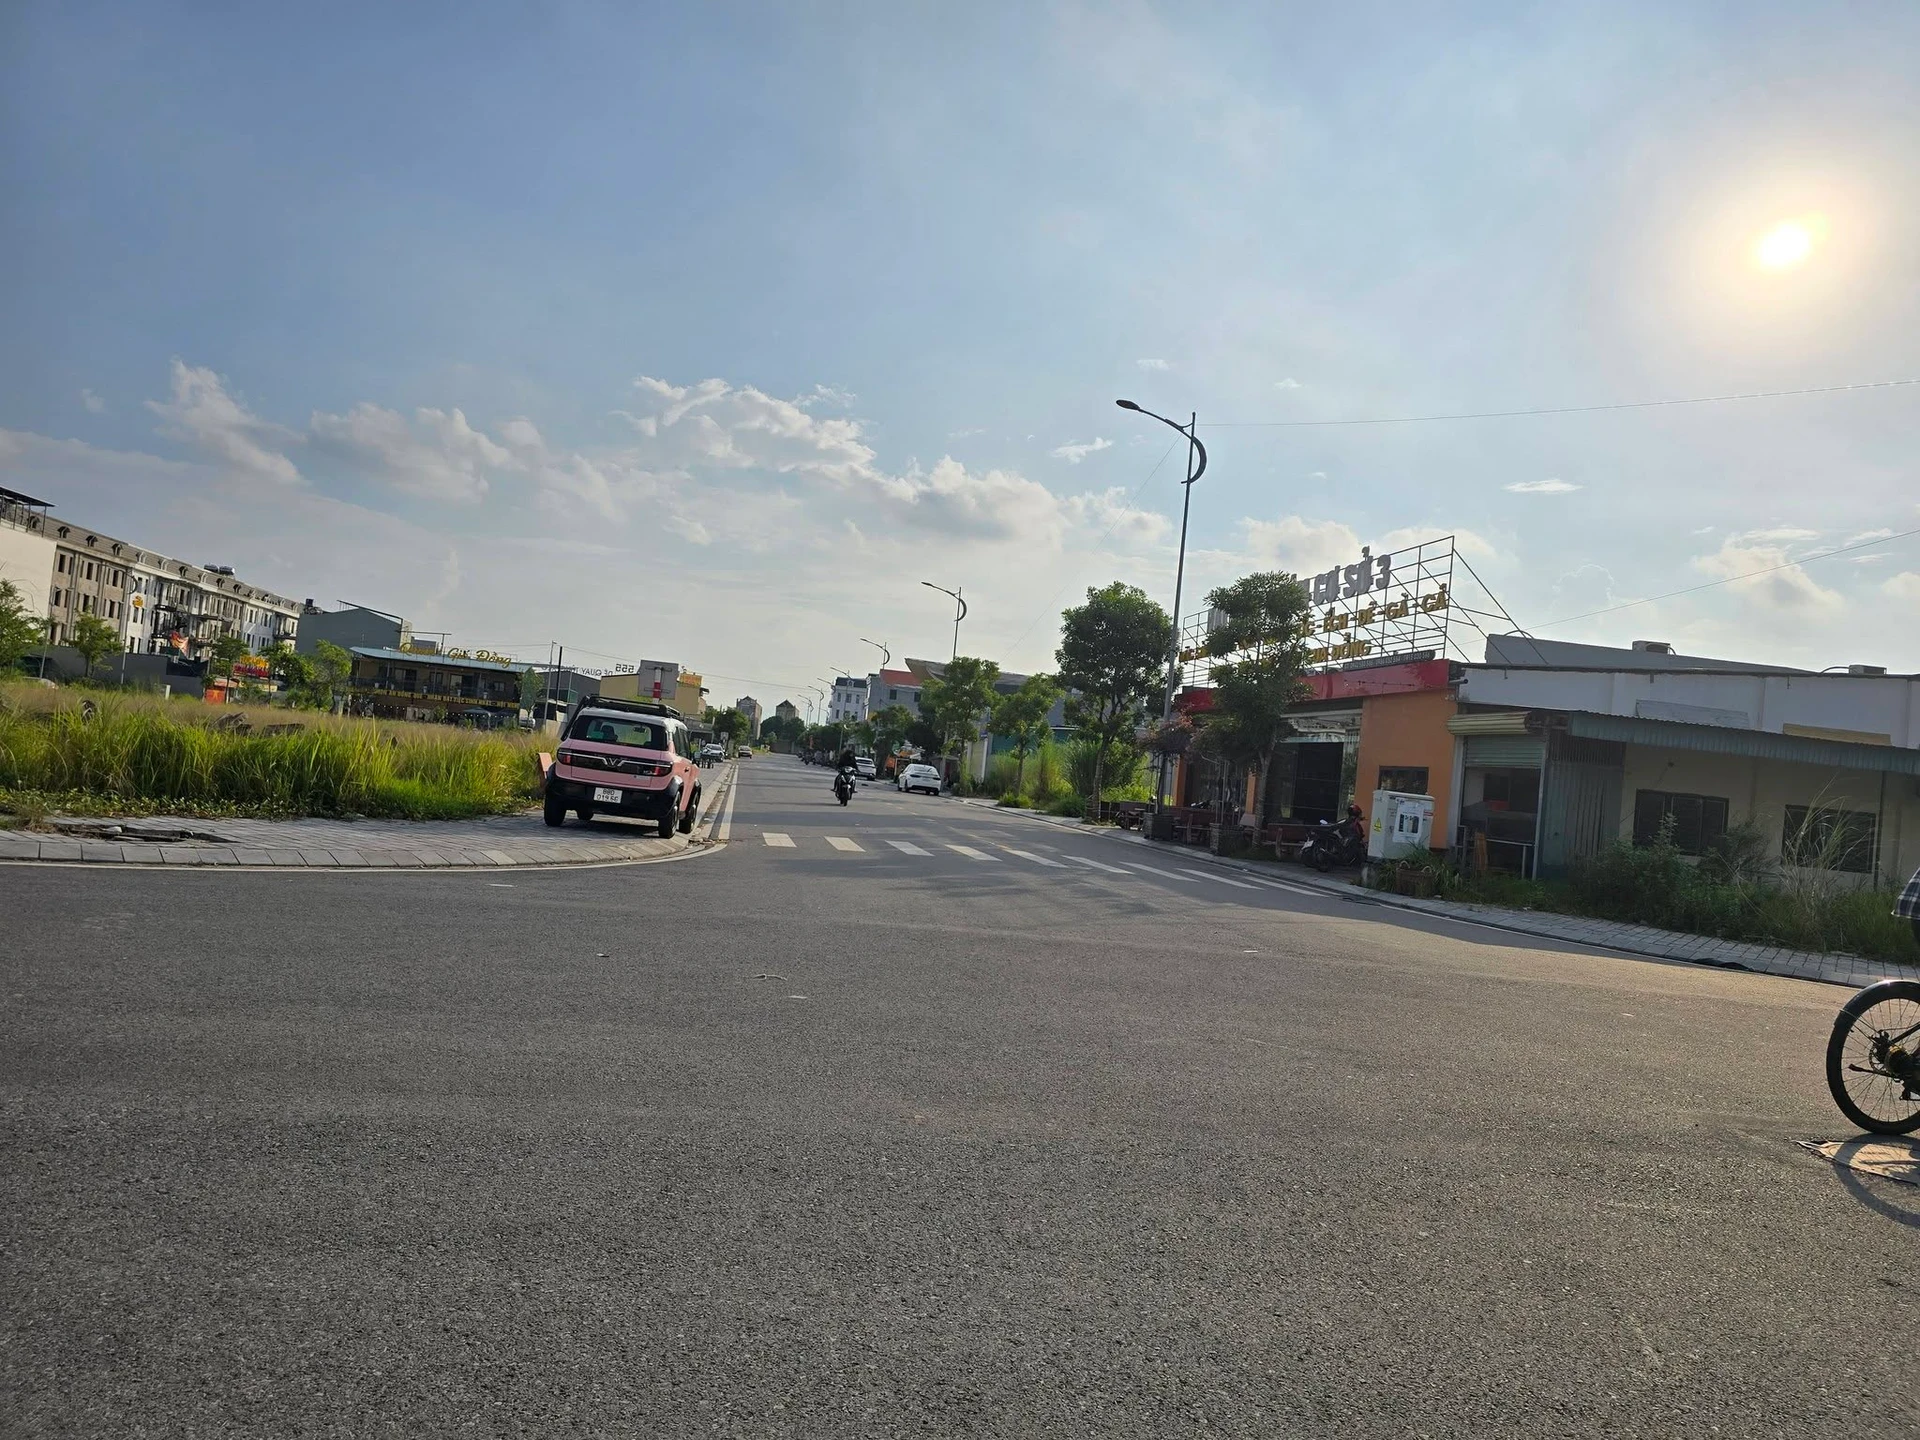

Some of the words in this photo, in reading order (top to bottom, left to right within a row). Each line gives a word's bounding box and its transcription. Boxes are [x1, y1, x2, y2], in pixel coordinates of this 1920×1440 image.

[1343, 545, 1374, 598] SỞ
[1375, 554, 1391, 590] 3
[1386, 592, 1409, 620] GÀ
